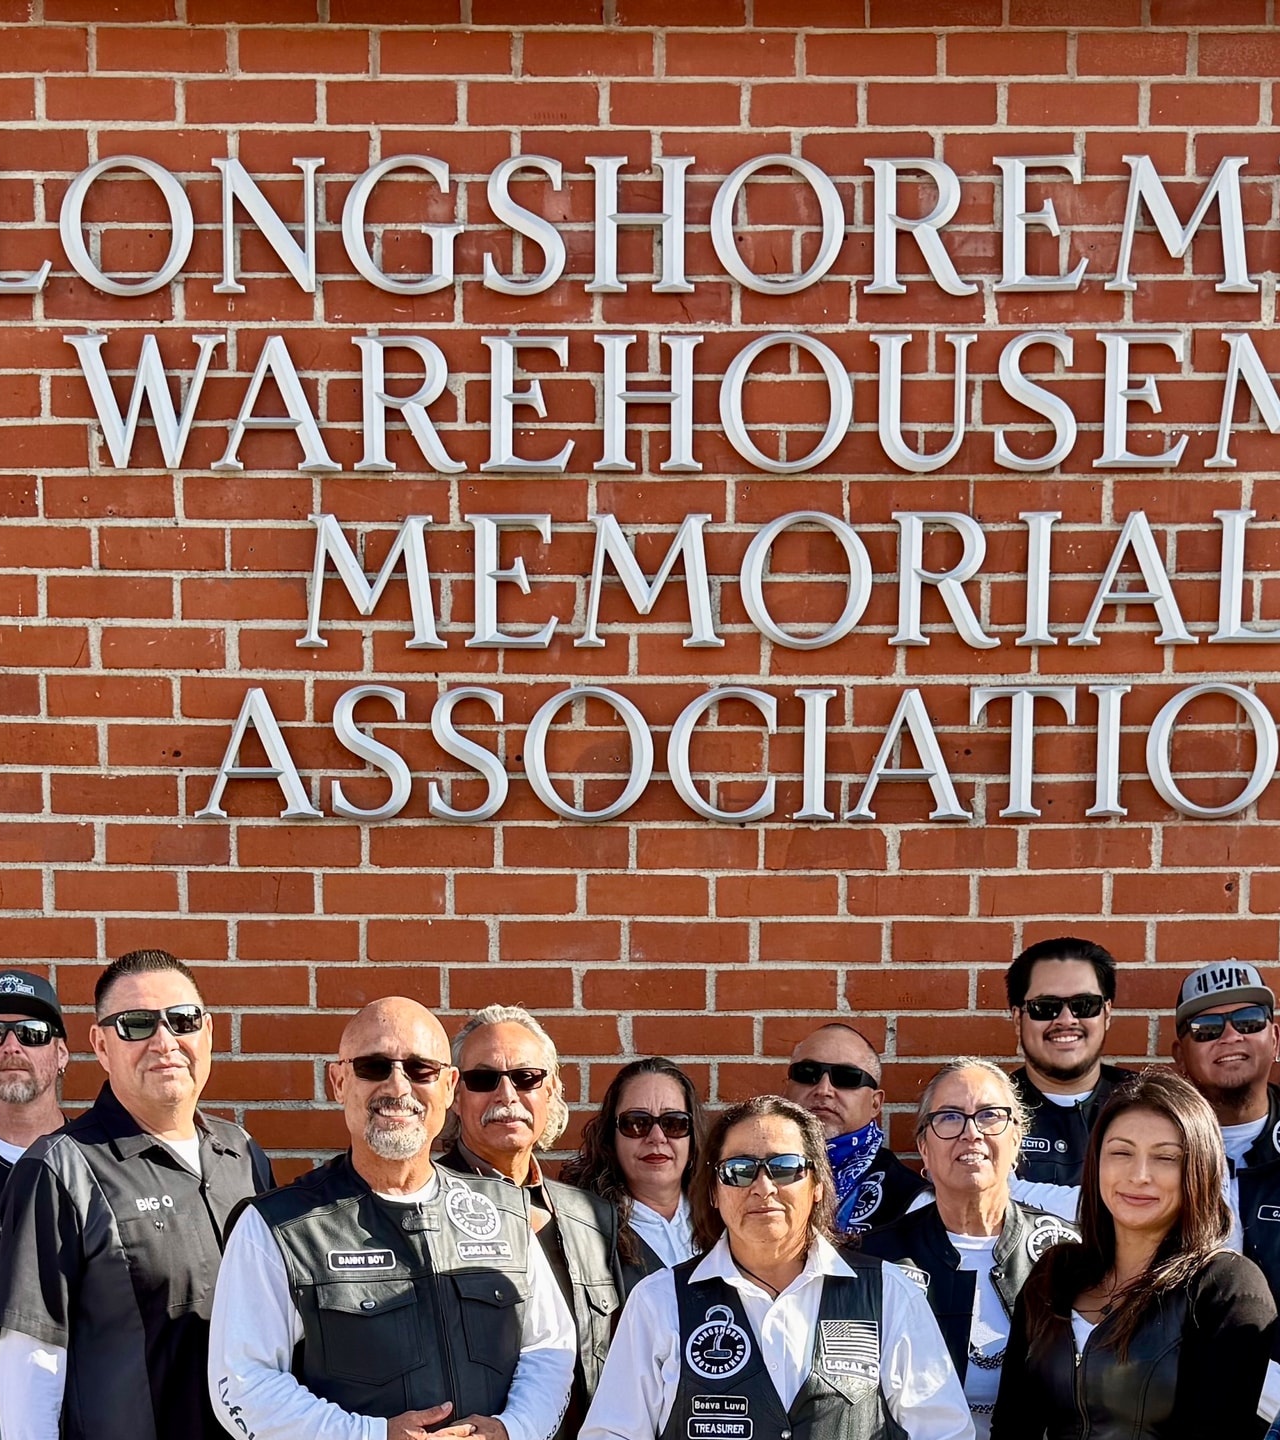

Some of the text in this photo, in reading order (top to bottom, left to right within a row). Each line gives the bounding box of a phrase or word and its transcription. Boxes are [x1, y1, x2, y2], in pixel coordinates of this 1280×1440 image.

[136, 1197, 160, 1211] BIG
[368, 1255, 385, 1264] BOY
[693, 1326, 742, 1346] LONGSHORE
[692, 1344, 745, 1374] BROTHERHOOD
[826, 1360, 866, 1373] LOCAL
[694, 1423, 745, 1435] TREASURER
